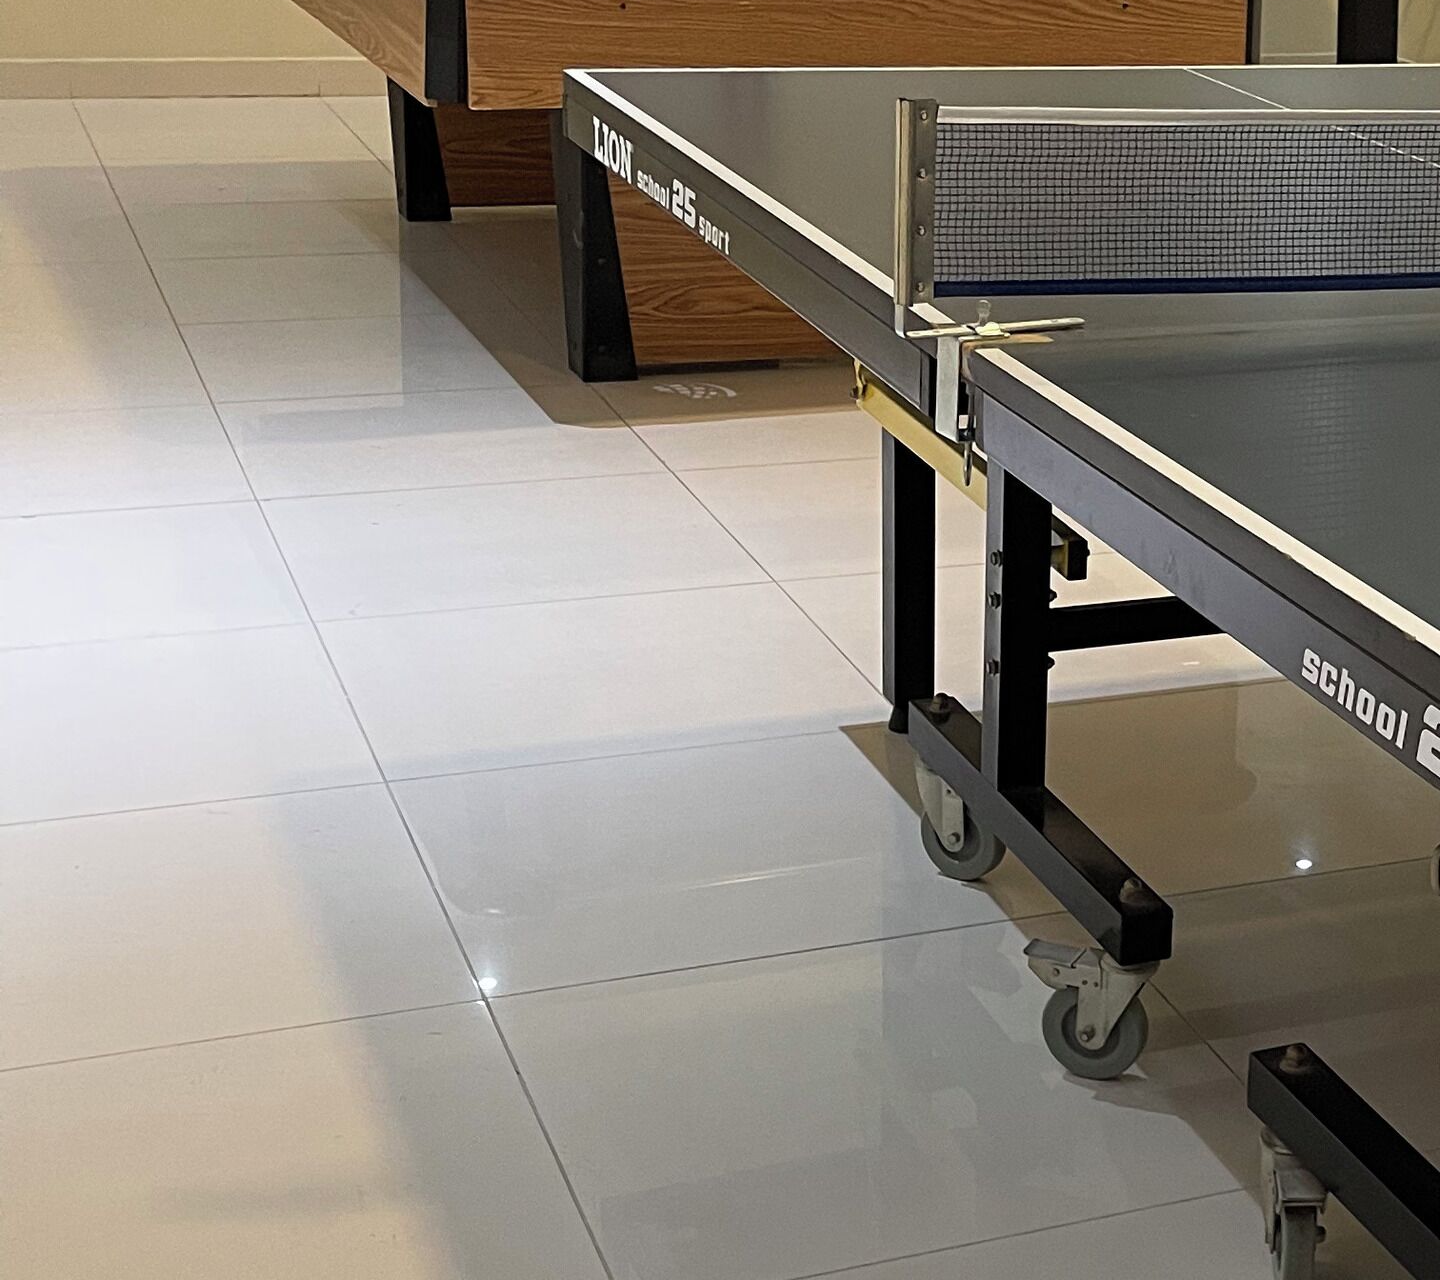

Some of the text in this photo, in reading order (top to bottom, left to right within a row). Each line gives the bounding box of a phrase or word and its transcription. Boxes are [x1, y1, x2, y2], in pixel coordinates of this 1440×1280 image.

[592, 115, 731, 255] LION school 25 sport
[1301, 648, 1409, 750] school
